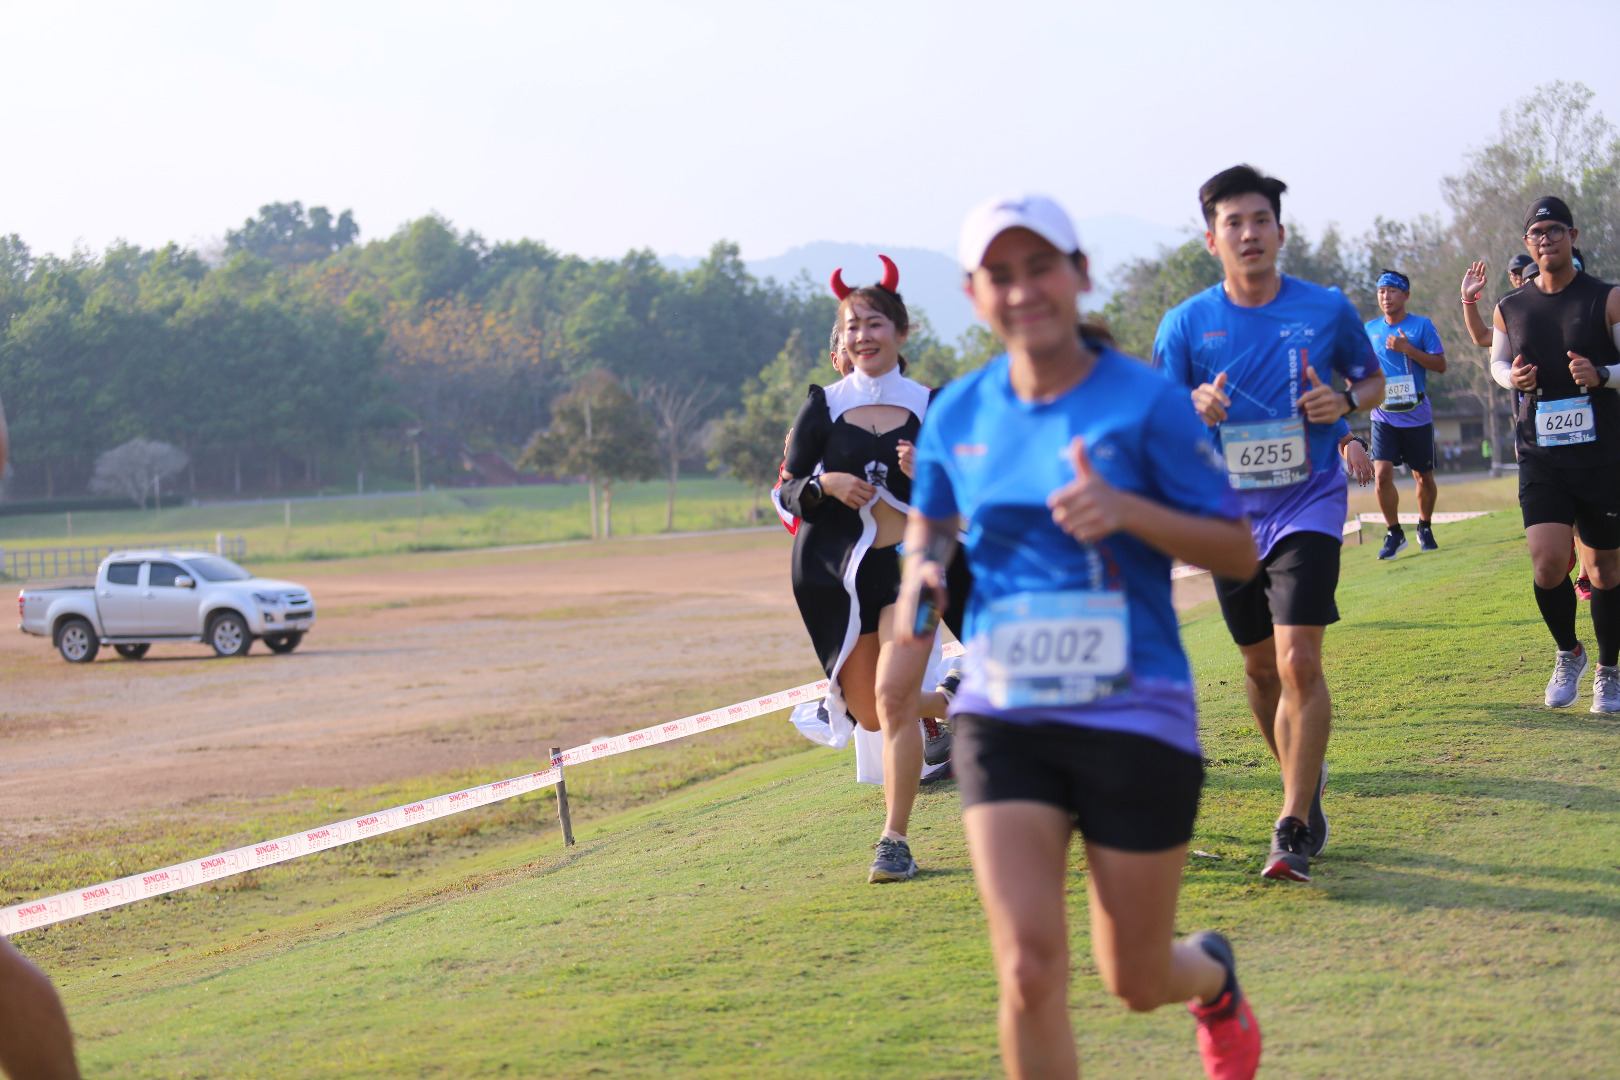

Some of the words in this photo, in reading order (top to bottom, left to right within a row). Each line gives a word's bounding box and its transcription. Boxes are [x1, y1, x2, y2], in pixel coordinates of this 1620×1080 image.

[1288, 348, 1298, 380] CROSS
[1388, 384, 1410, 395] 6078
[1289, 380, 1298, 419] COUNTR
[1546, 412, 1583, 431] 6240
[1240, 442, 1292, 466] 6255
[1006, 626, 1103, 666] 6002
[356, 816, 378, 828] SINGHA
[307, 830, 330, 842] SINGHA
[255, 843, 279, 855] SINGHA
[200, 857, 226, 870] SINGHA
[143, 872, 169, 885] SINGHA
[82, 888, 110, 902] SINGHA
[18, 904, 47, 918] SINGHA
[20, 912, 48, 927] SERIES
